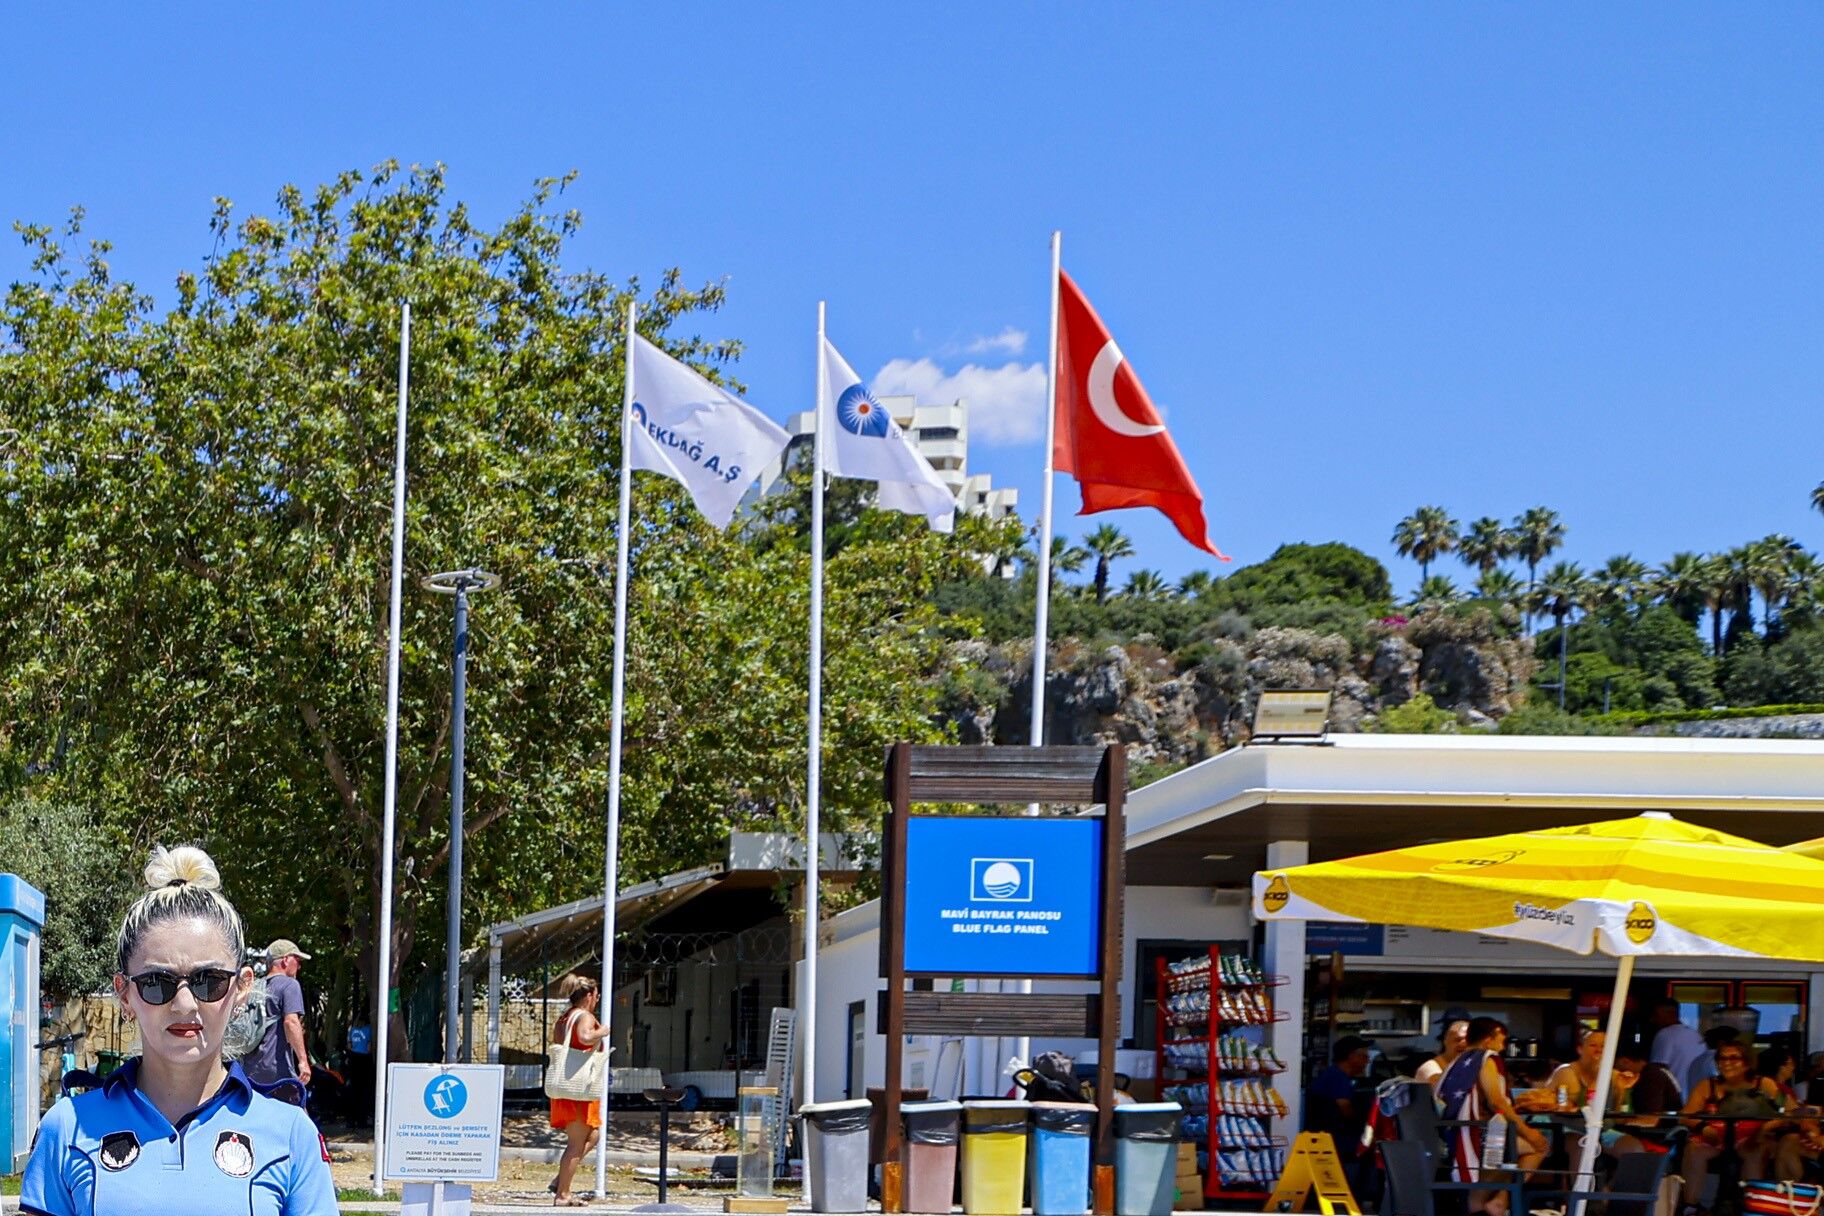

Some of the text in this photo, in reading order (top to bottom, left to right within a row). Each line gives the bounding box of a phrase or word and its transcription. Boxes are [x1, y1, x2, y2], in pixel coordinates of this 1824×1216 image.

[941, 907, 1061, 921] MAVİ BAYRAK PANOSU
[952, 923, 1049, 934] BLUE FLAG PANEL
